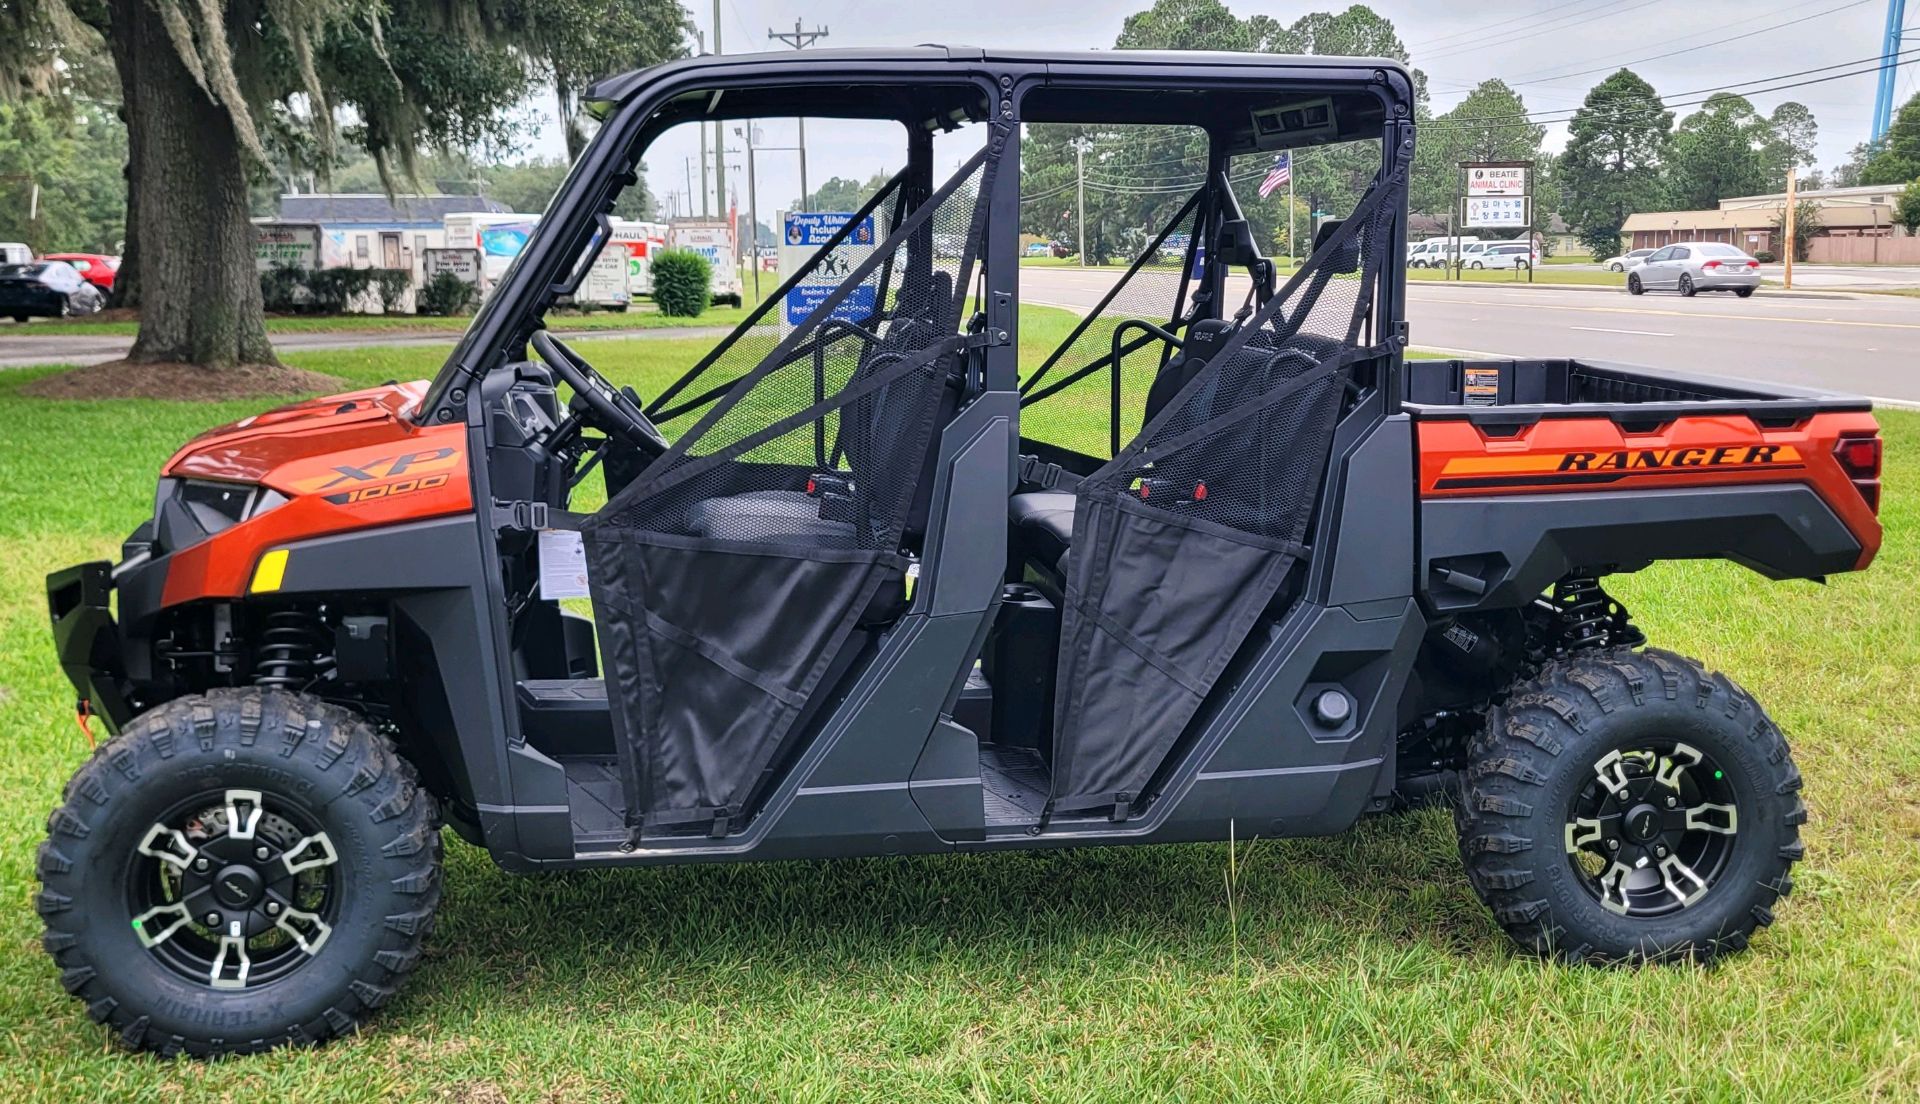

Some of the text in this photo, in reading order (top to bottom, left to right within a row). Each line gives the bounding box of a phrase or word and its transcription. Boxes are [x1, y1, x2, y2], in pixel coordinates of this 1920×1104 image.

[1489, 170, 1519, 178] BEATIE
[1470, 180, 1523, 189] ANIMAL CLINIC
[791, 215, 820, 226] Deputy
[1556, 445, 1782, 472] RANGER
[315, 448, 456, 490] XP
[347, 474, 450, 504] 1000
